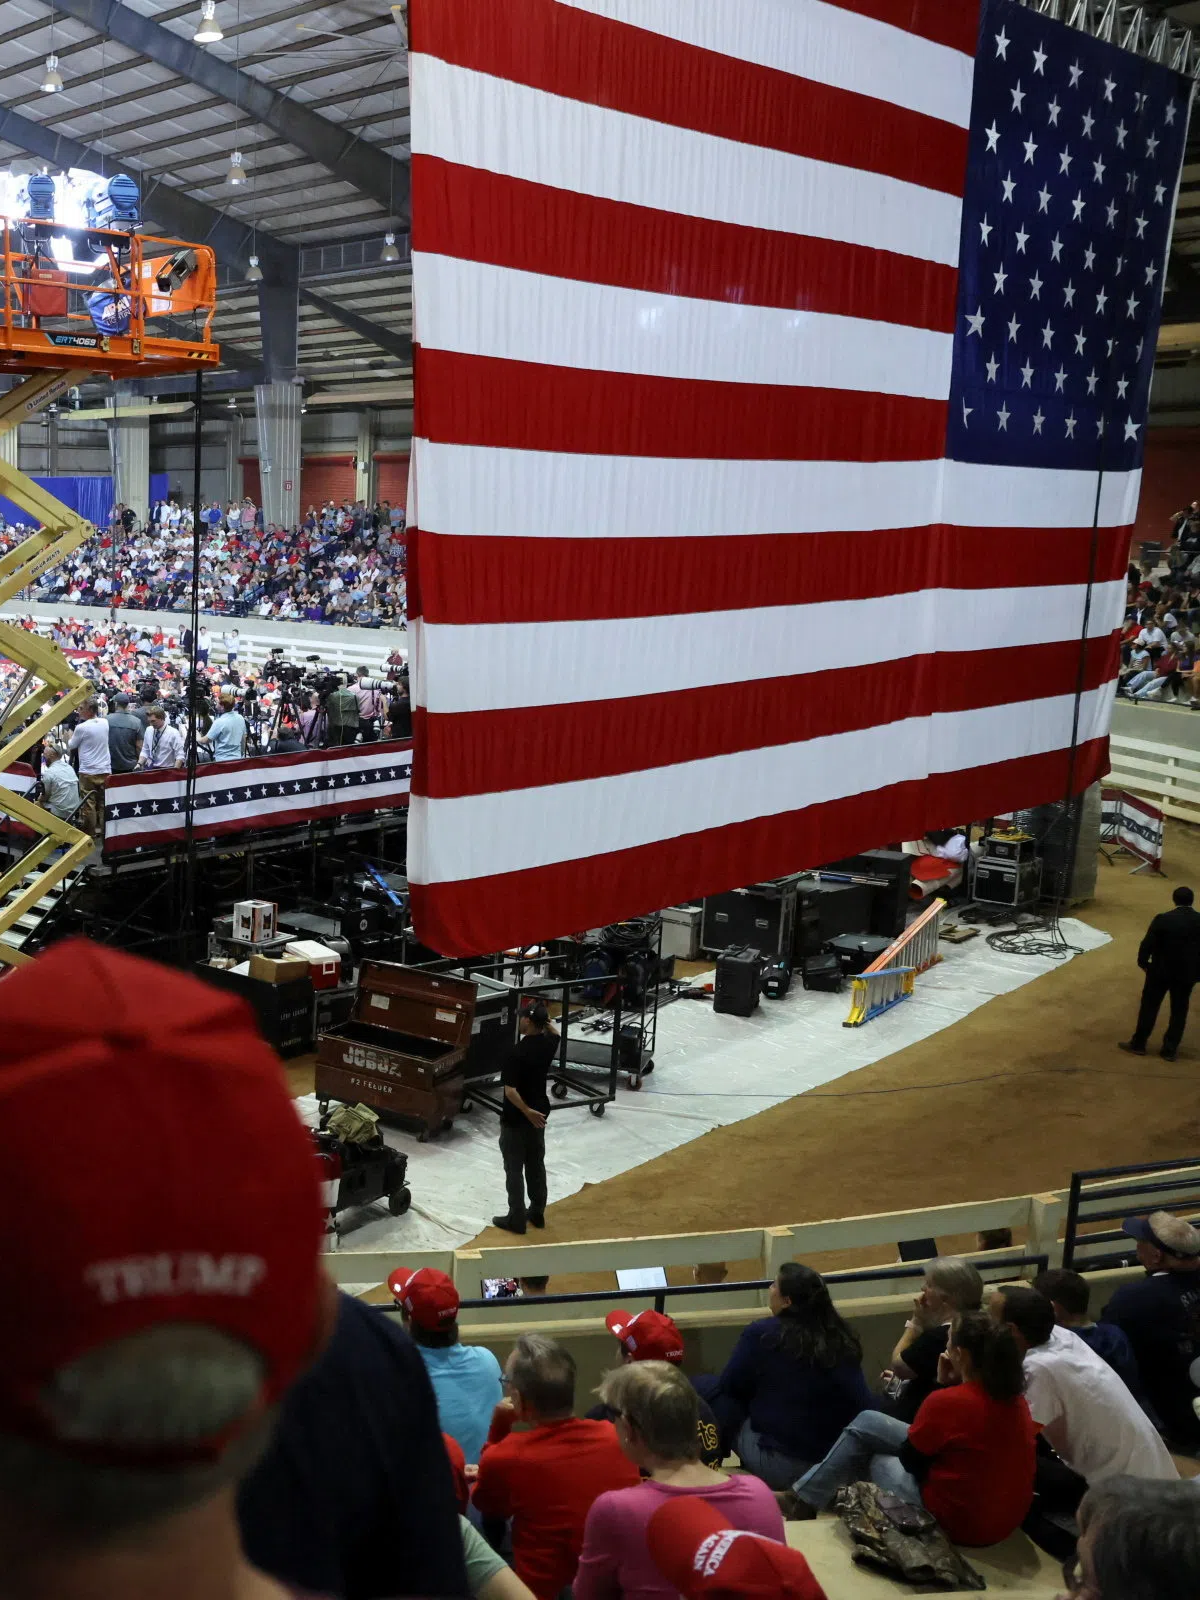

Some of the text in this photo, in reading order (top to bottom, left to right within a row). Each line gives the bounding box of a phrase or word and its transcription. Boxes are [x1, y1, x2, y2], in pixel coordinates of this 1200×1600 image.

[55, 336, 97, 346] ERT4069
[33, 391, 49, 406] United
[83, 1251, 268, 1305] TRUMP
